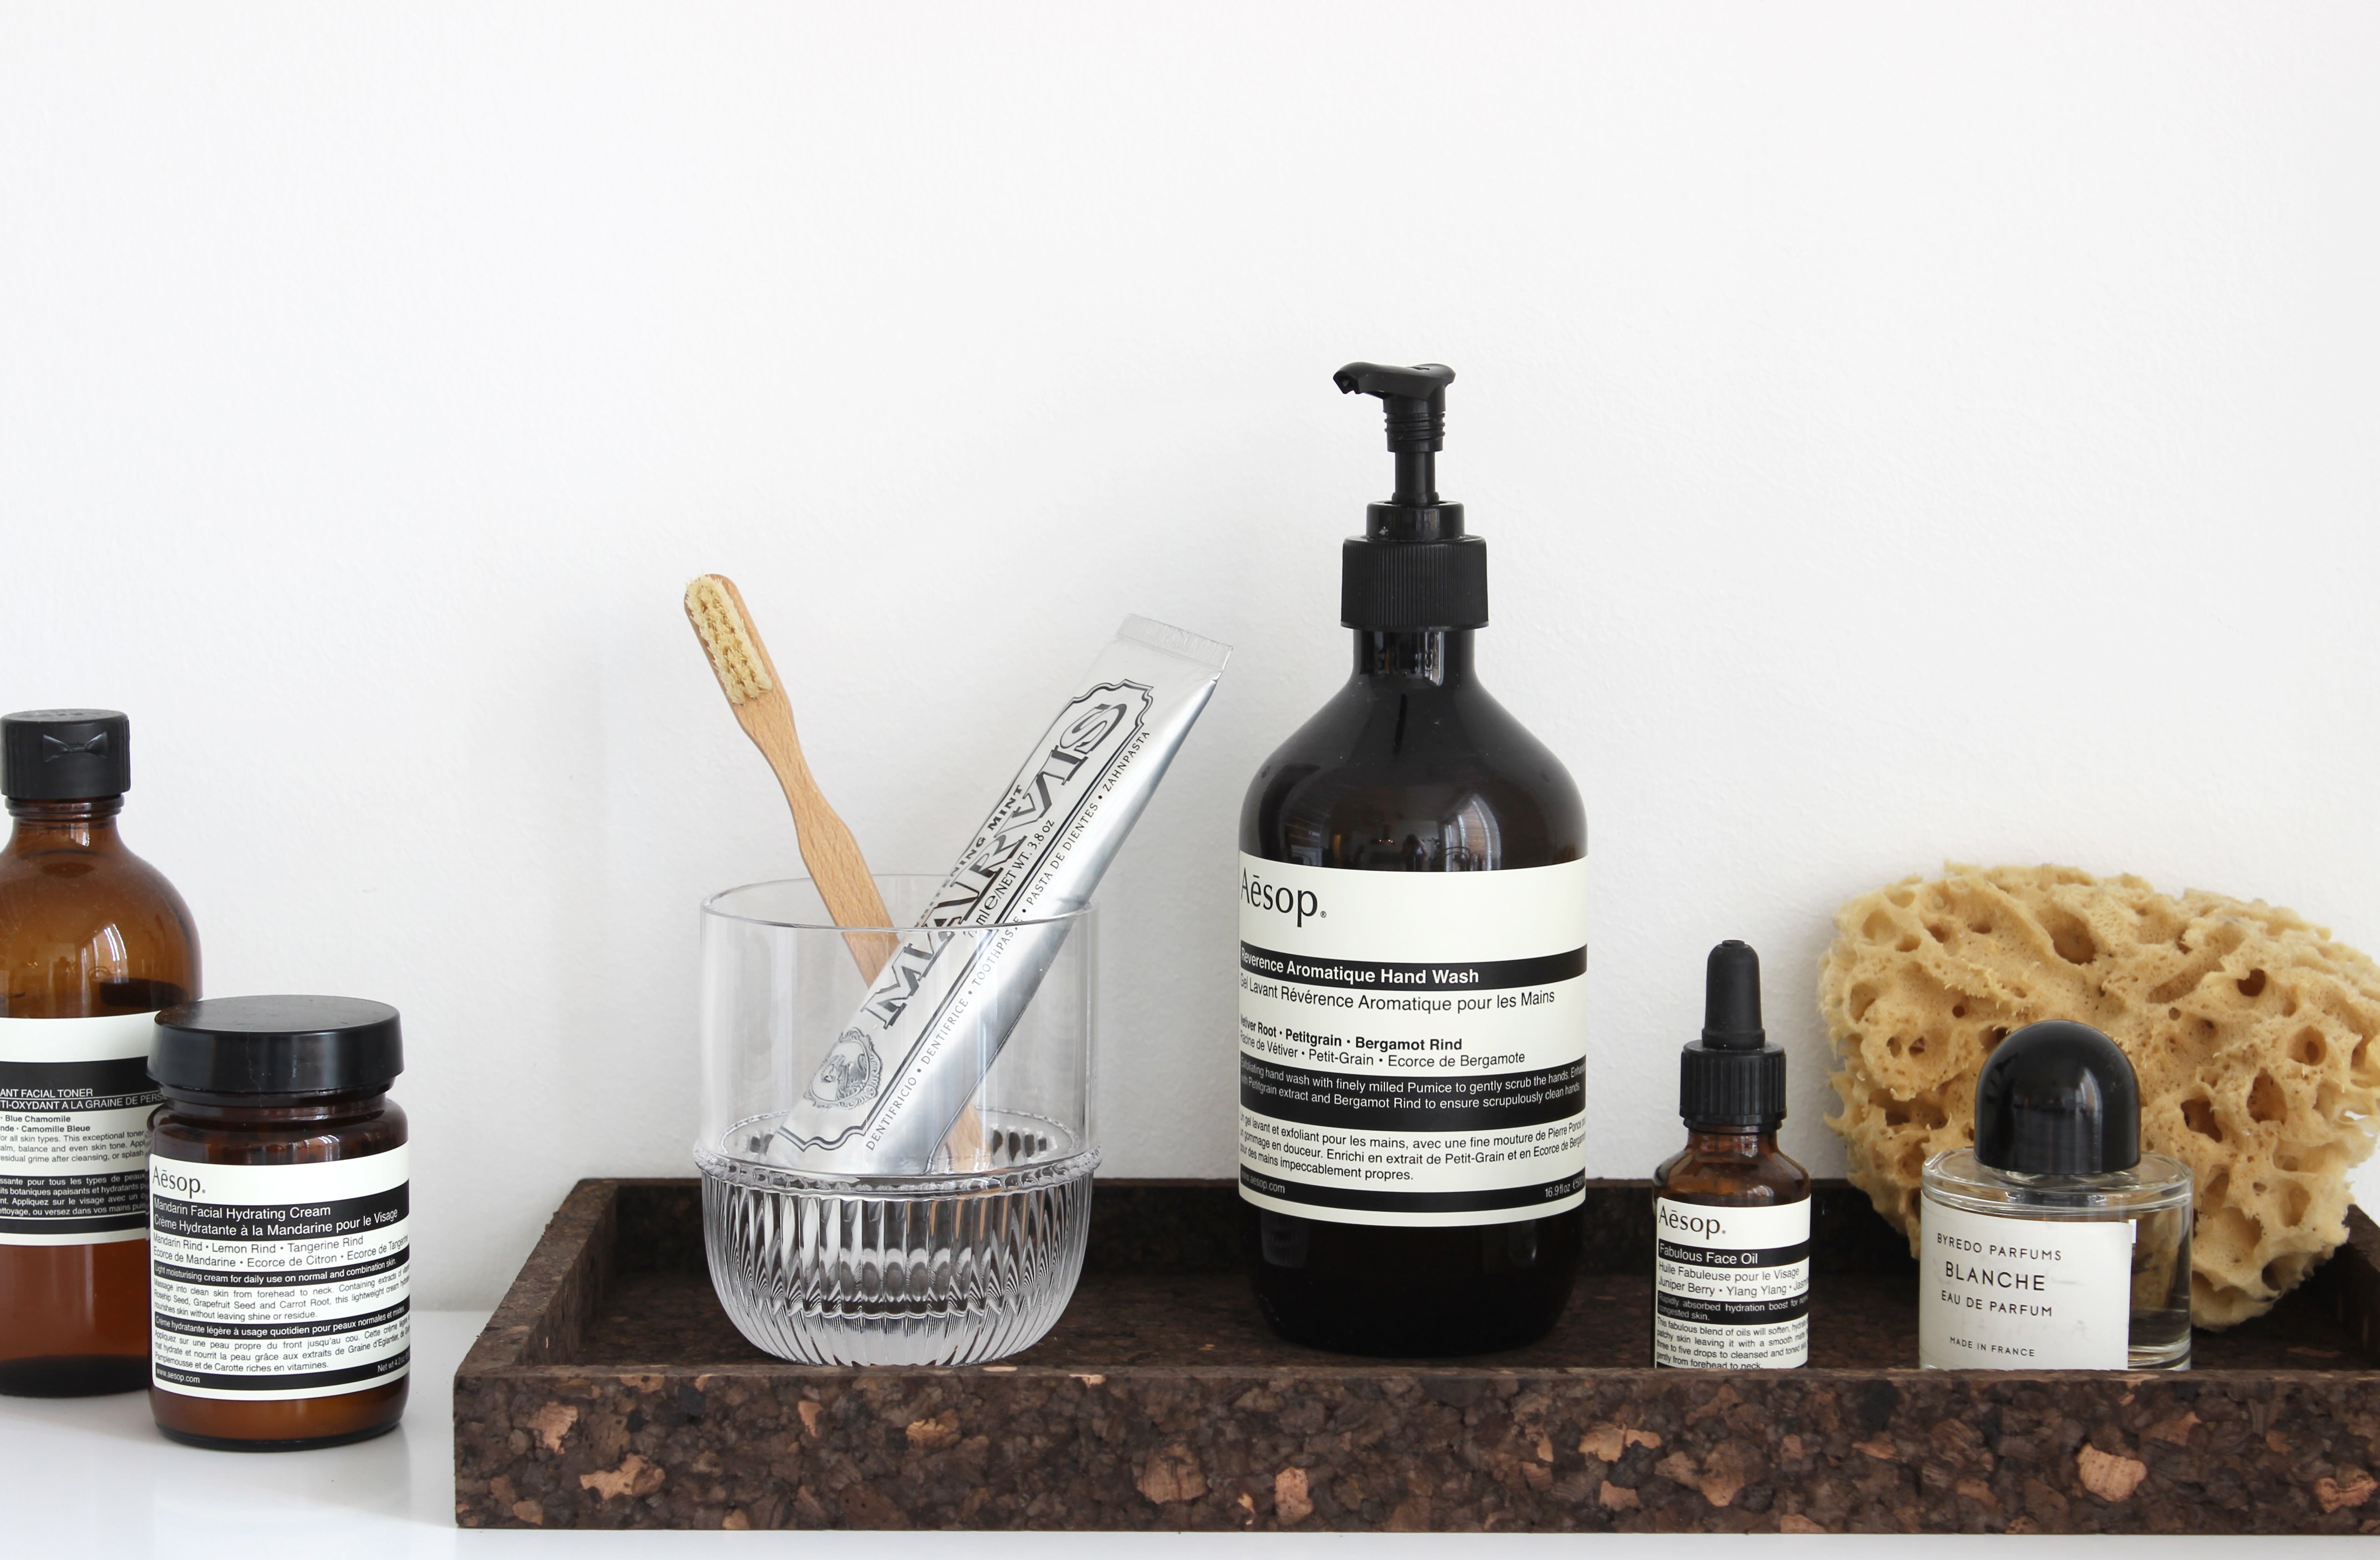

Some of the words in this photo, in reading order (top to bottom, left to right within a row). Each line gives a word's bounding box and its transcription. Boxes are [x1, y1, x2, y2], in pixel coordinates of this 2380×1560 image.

[988, 785, 1022, 831] MINT
[1027, 833, 1045, 850] 3.8
[860, 703, 1127, 1030] MARVIS
[866, 1077, 917, 1150] DENTIFRICIO
[921, 998, 968, 1065] DENTIFRICE
[1026, 873, 1052, 905] PASTA
[1051, 852, 1065, 870] DE
[1063, 802, 1098, 851] DIENTES
[1103, 732, 1149, 792] ZAHNPASTA
[1241, 947, 1283, 973] Reverence
[1287, 961, 1375, 985] Aromatique
[1381, 969, 1426, 984] Hand
[1432, 969, 1478, 983] Wash
[1250, 978, 1277, 998] Lavant
[1281, 986, 1353, 1008] Révérence
[1358, 995, 1451, 1014] Aromatique
[1458, 998, 1492, 1014] pour
[1497, 995, 1516, 1008] les
[1522, 990, 1554, 1006] Mains
[1258, 1022, 1276, 1038] Root
[1286, 1028, 1342, 1047] Petitgrain
[1356, 1037, 1425, 1053] Bergamot
[1430, 1039, 1462, 1050] Rind
[1257, 1040, 1264, 1050] de
[1267, 1040, 1298, 1057] Vétiver
[1309, 1048, 1373, 1065] Petit-Grain
[1388, 1055, 1434, 1067] Ecorce
[1440, 1055, 1455, 1067] de
[1461, 1052, 1525, 1069] Bergamote
[1266, 1067, 1283, 1081] hand
[1286, 1074, 1309, 1085] wash
[1313, 1077, 1333, 1088] with
[1336, 1078, 1365, 1093] finely
[1369, 1081, 1403, 1092] milled
[1408, 1082, 1452, 1092] Pumice
[1455, 1083, 1466, 1092] to
[1470, 1080, 1502, 1094] gently
[1505, 1077, 1531, 1089] scrub
[1534, 1076, 1546, 1086] the
[1549, 1070, 1569, 1083] hands.
[21, 1089, 56, 1098] FACIAL
[57, 1088, 93, 1098] TONER
[61, 1101, 68, 1109] A
[71, 1100, 83, 1109] LA
[85, 1098, 122, 1108] GRAINE
[126, 1096, 137, 1105] DE
[1322, 1135, 1346, 1145] pour
[1350, 1135, 1366, 1146] les
[1370, 1137, 1408, 1150] mains,
[1445, 1140, 1466, 1148] une
[1470, 1137, 1490, 1147] fine
[1494, 1134, 1533, 1146] mouture
[1281, 1158, 1361, 1177] impeccablement
[1365, 1170, 1413, 1181] propres.
[86, 1177, 106, 1186] types
[12, 1197, 49, 1207] Appliquez
[154, 1197, 187, 1215] Mandarin
[191, 1205, 222, 1218] Facial
[227, 1208, 285, 1222] Hydrating
[290, 1207, 330, 1218] Cream
[154, 1214, 177, 1229] Crème
[179, 1220, 237, 1235] Hydratante
[241, 1225, 248, 1236] à
[253, 1225, 263, 1236] la
[268, 1222, 332, 1235] Mandarine
[336, 1219, 360, 1233] pour
[364, 1216, 371, 1226] le
[374, 1209, 397, 1223] Visage
[183, 1240, 202, 1251] Rind
[212, 1243, 247, 1253] Lemon
[251, 1244, 276, 1253] Rind
[287, 1241, 339, 1254] Tangerine
[343, 1235, 363, 1247] Rind
[1660, 1243, 1702, 1262] Fabulous
[1707, 1252, 1737, 1264] Face
[1741, 1253, 1758, 1264] Oil
[1938, 1233, 1982, 1253] BYREDO
[1990, 1245, 2061, 1261] PARFUMS
[174, 1252, 184, 1262] de
[187, 1254, 236, 1267] Mandarine
[247, 1258, 285, 1267] Ecorce
[289, 1257, 302, 1266] de
[306, 1255, 336, 1265] Citron
[347, 1248, 376, 1260] Ecorce
[379, 1245, 387, 1254] de
[166, 1269, 202, 1282] moisturising
[244, 1275, 264, 1285] daily
[298, 1271, 327, 1281] normal
[330, 1269, 344, 1278] and
[346, 1263, 385, 1276] combination
[1659, 1261, 1675, 1275] Huile
[1679, 1266, 1731, 1281] Fabuleuse
[1735, 1274, 1759, 1283] pour
[1762, 1271, 1770, 1280] le
[1774, 1268, 1799, 1279] Visage
[1946, 1261, 2044, 1291] BLANCHE
[1658, 1276, 1685, 1291] Juniper
[1688, 1283, 1715, 1297] Berry
[1726, 1286, 1757, 1298] Ylang
[1761, 1285, 1786, 1295] Ylang
[1683, 1300, 1721, 1311] absorbed
[1726, 1304, 1765, 1313] hydration
[1769, 1301, 1788, 1310] boost
[1942, 1290, 1960, 1305] EAU
[1967, 1297, 1982, 1309] DE
[1990, 1301, 2052, 1316] PARFUM
[190, 1310, 215, 1319] without
[217, 1312, 245, 1322] leaving
[284, 1311, 317, 1319] residue.
[1668, 1321, 1697, 1333] fabulous
[1700, 1326, 1723, 1336] blend
[1768, 1324, 1790, 1335] soften,
[1677, 1335, 1691, 1343] skin
[1695, 1337, 1724, 1349] leaving
[1768, 1336, 1792, 1346] smooth
[1679, 1345, 1691, 1355] five
[1694, 1348, 1717, 1359] drops
[1731, 1346, 1768, 1359] cleansed
[1771, 1348, 1783, 1357] and
[1950, 1337, 1972, 1348] MADE
[1992, 1345, 2034, 1357] FRANCE
[157, 1369, 200, 1383] www.aesop.com
